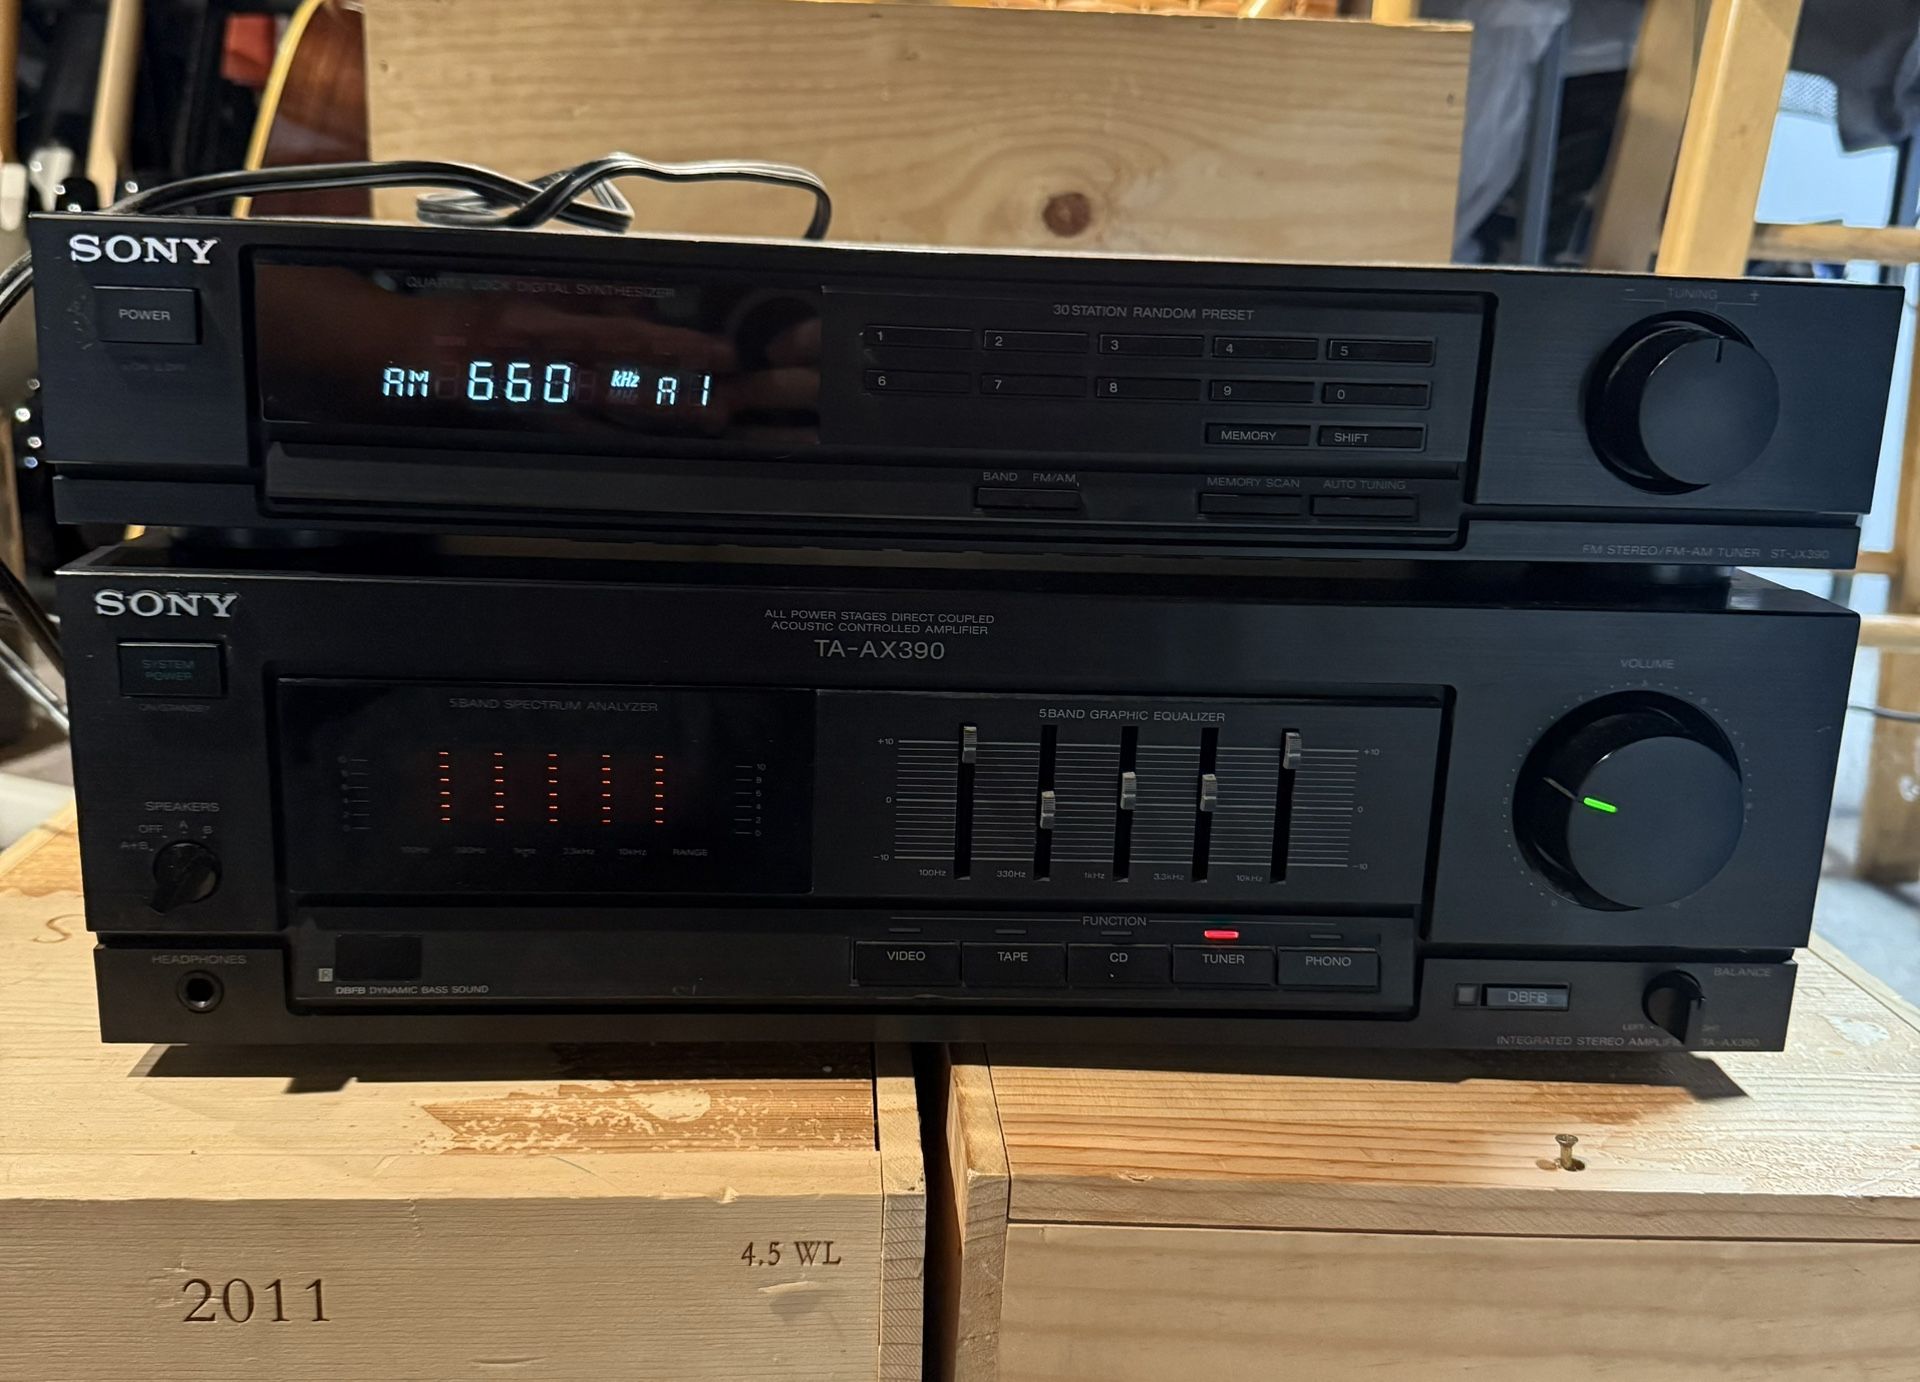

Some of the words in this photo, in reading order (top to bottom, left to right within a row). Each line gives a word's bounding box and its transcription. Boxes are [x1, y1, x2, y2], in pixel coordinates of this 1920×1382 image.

[68, 234, 219, 264] SONY
[516, 280, 568, 295] DIGITAL
[575, 283, 675, 298] SYNTHESIZER
[1668, 287, 1718, 300] TUNING
[118, 308, 171, 321] POWER
[1133, 307, 1196, 319] RANDOM
[1201, 309, 1255, 321] PRESET
[876, 330, 883, 341] 1
[994, 336, 1003, 346] 2
[1110, 340, 1119, 350] 3
[1225, 343, 1234, 354] 4
[1340, 346, 1349, 356] 5
[382, 366, 429, 399] AM
[467, 360, 572, 403] 660
[611, 369, 641, 389] kHz
[656, 375, 678, 406] A
[877, 376, 886, 386] 6
[994, 379, 1002, 390] 7
[1109, 382, 1118, 393] 8
[1223, 385, 1232, 396] 9
[1336, 389, 1345, 400] 0
[1221, 430, 1277, 441] MEMORY
[1334, 432, 1369, 443] SHIFT
[983, 472, 1018, 481] BAND
[1032, 473, 1077, 483] FM/AM
[1207, 477, 1261, 488] MEMORY
[1265, 478, 1300, 488] SCAN
[1323, 479, 1356, 489] AUTO
[1360, 480, 1406, 490] TUNING
[1582, 544, 1602, 555] FM
[1718, 547, 1760, 558] TUNER
[94, 588, 239, 618] SONY
[764, 609, 787, 619] ALL
[790, 610, 836, 620] POWER
[840, 611, 887, 621] STAGES
[891, 612, 933, 623] DIRECT
[938, 614, 995, 624] COUPLED
[771, 621, 834, 632] ACOUSTIC
[838, 623, 920, 633] CONTROLLED
[925, 625, 988, 635] AMPLIFIER
[814, 639, 945, 660] TA-AX390
[141, 659, 195, 670] SYSTEM
[1620, 658, 1675, 669] VOLUME
[145, 671, 193, 681] POWER
[502, 699, 582, 711] SPECTRUM
[586, 701, 658, 713] ANALYZER
[1089, 710, 1149, 720] GRAPHIC
[1154, 711, 1225, 722] EQUALIZER
[145, 801, 220, 812] SPEAKERS
[138, 824, 163, 833] OFF
[179, 820, 188, 829] A
[202, 825, 213, 834] B
[919, 869, 947, 877] 100Hz
[1082, 916, 1147, 927] FUNCTION
[151, 954, 247, 965] HEADPHONES
[886, 951, 926, 962] VIDEO
[997, 952, 1028, 963] TAPE
[1109, 952, 1128, 963] CD
[1203, 954, 1245, 965] TUNER
[1305, 956, 1352, 967] PHONO
[1713, 967, 1772, 978] BALANCE
[369, 985, 418, 994] DYNAMIC
[421, 985, 448, 994] BASS
[452, 984, 489, 994] SOUND
[1508, 991, 1549, 1003] DBFB
[1497, 1036, 1573, 1046] INTEGRATED
[1577, 1036, 1624, 1046] STEREO
[794, 1242, 843, 1267] WL
[183, 1277, 331, 1324] 2011
